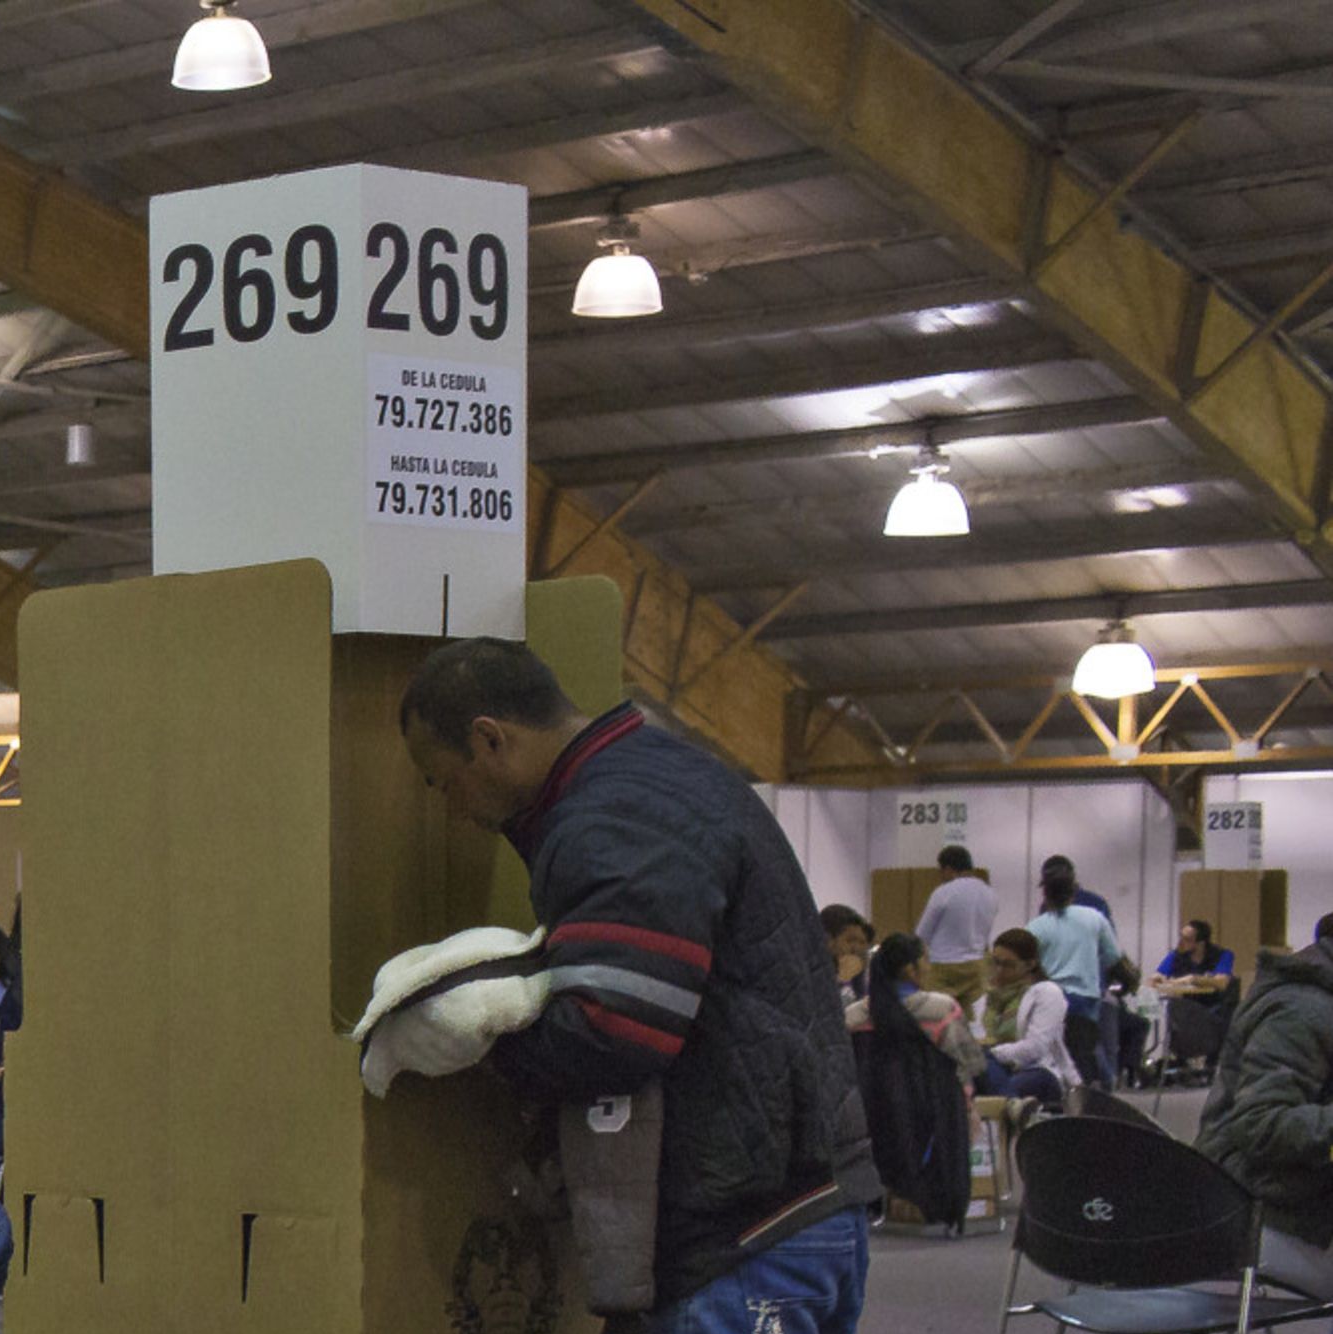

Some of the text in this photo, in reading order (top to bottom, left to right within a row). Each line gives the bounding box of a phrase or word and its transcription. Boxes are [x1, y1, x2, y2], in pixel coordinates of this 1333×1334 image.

[162, 223, 339, 352] 269
[366, 222, 509, 341] 269
[401, 369, 486, 393] DE LA CEDULA
[375, 393, 512, 436] 79.727.386
[390, 455, 498, 479] HASTA LA CEDULA
[375, 481, 512, 521] 79.731.806
[900, 802, 940, 825] 283
[1208, 809, 1245, 831] 282
